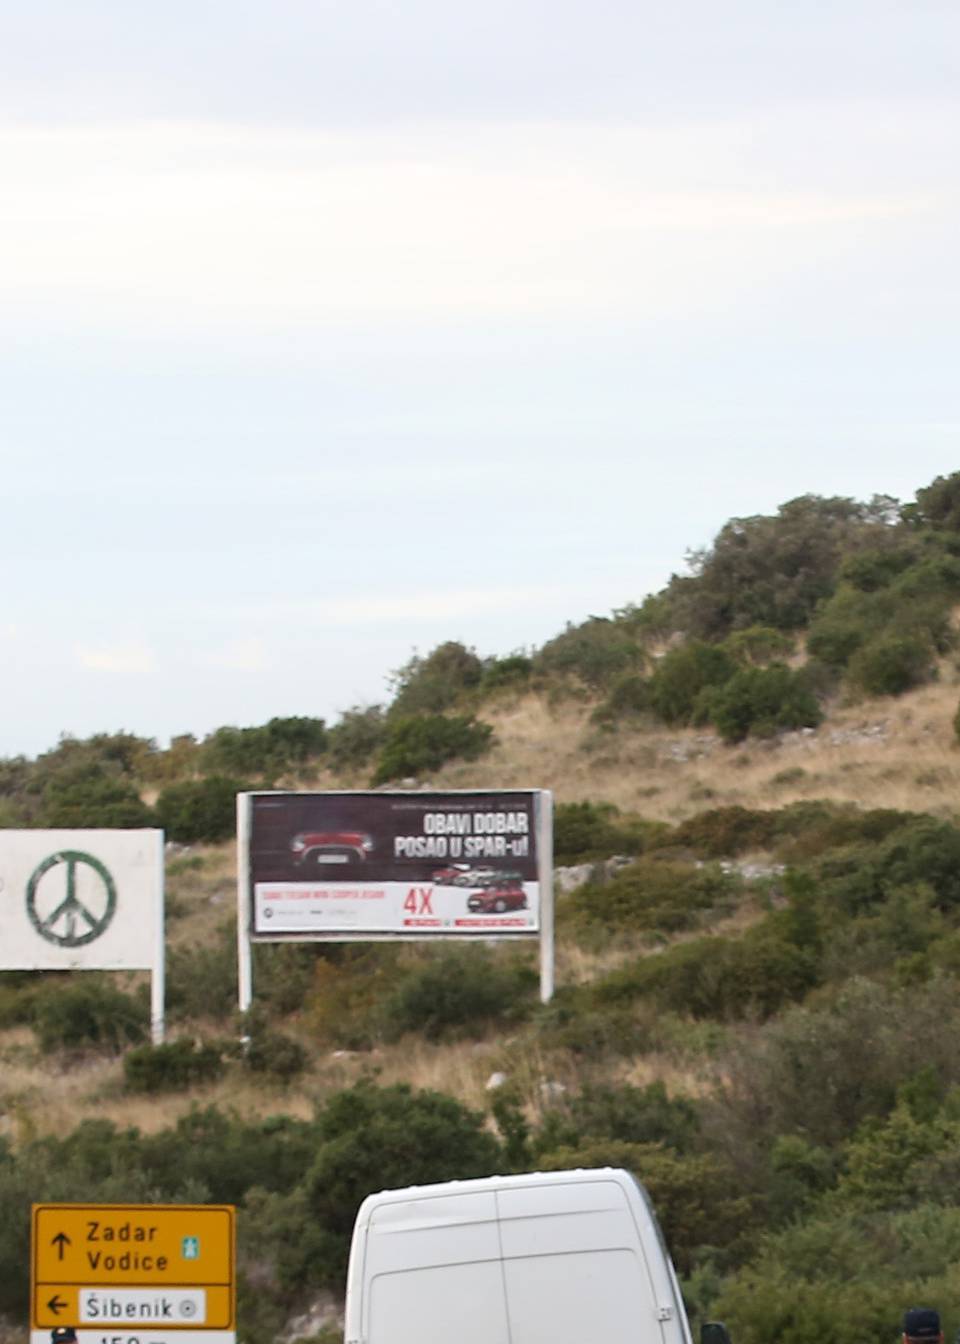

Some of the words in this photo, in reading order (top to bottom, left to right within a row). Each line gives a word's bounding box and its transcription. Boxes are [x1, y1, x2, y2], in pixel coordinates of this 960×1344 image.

[423, 813, 471, 834] OBAVI
[473, 812, 529, 834] DOBAR
[394, 836, 447, 857] POSAO
[450, 837, 462, 857] U
[464, 836, 528, 857] SPAR-u!
[404, 888, 433, 914] 4X
[86, 1221, 157, 1241] Zadar
[87, 1251, 168, 1270] Vodice
[86, 1293, 173, 1317] Šibenik
